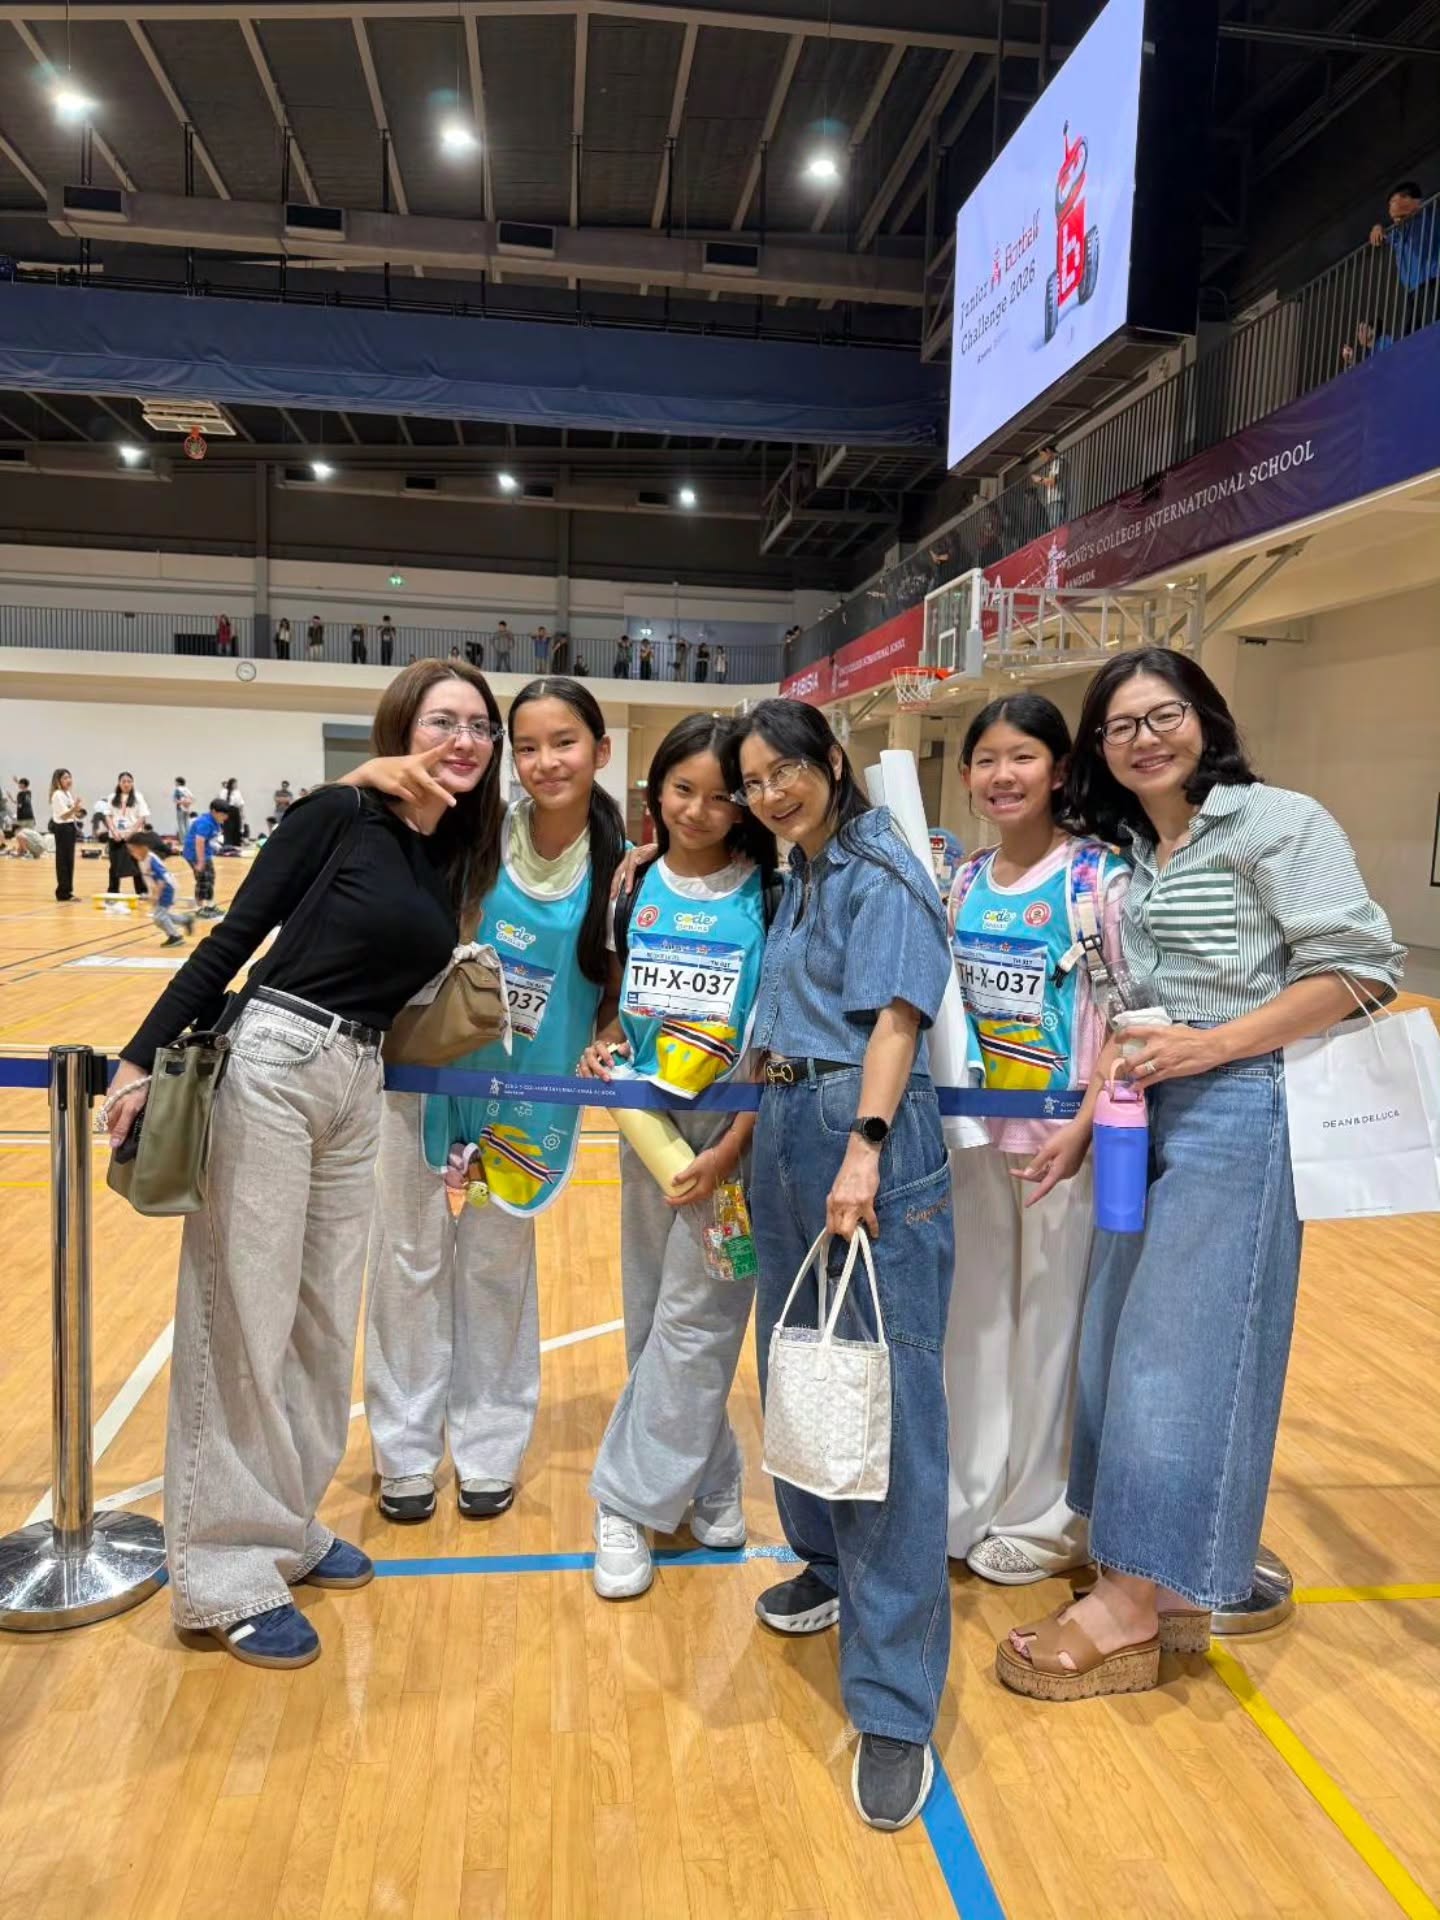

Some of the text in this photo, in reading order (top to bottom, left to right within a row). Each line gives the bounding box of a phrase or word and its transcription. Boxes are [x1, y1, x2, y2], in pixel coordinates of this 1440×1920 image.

[961, 296, 1007, 355] Challenge
[1010, 258, 1036, 305] 2026
[1096, 519, 1142, 555] COLLEGE
[1144, 472, 1246, 534] INTERNATIONAL
[1249, 439, 1315, 485] SCHOOL
[675, 911, 711, 925] code
[631, 965, 736, 996] TH-X-037
[957, 963, 1041, 995] TH-X-037
